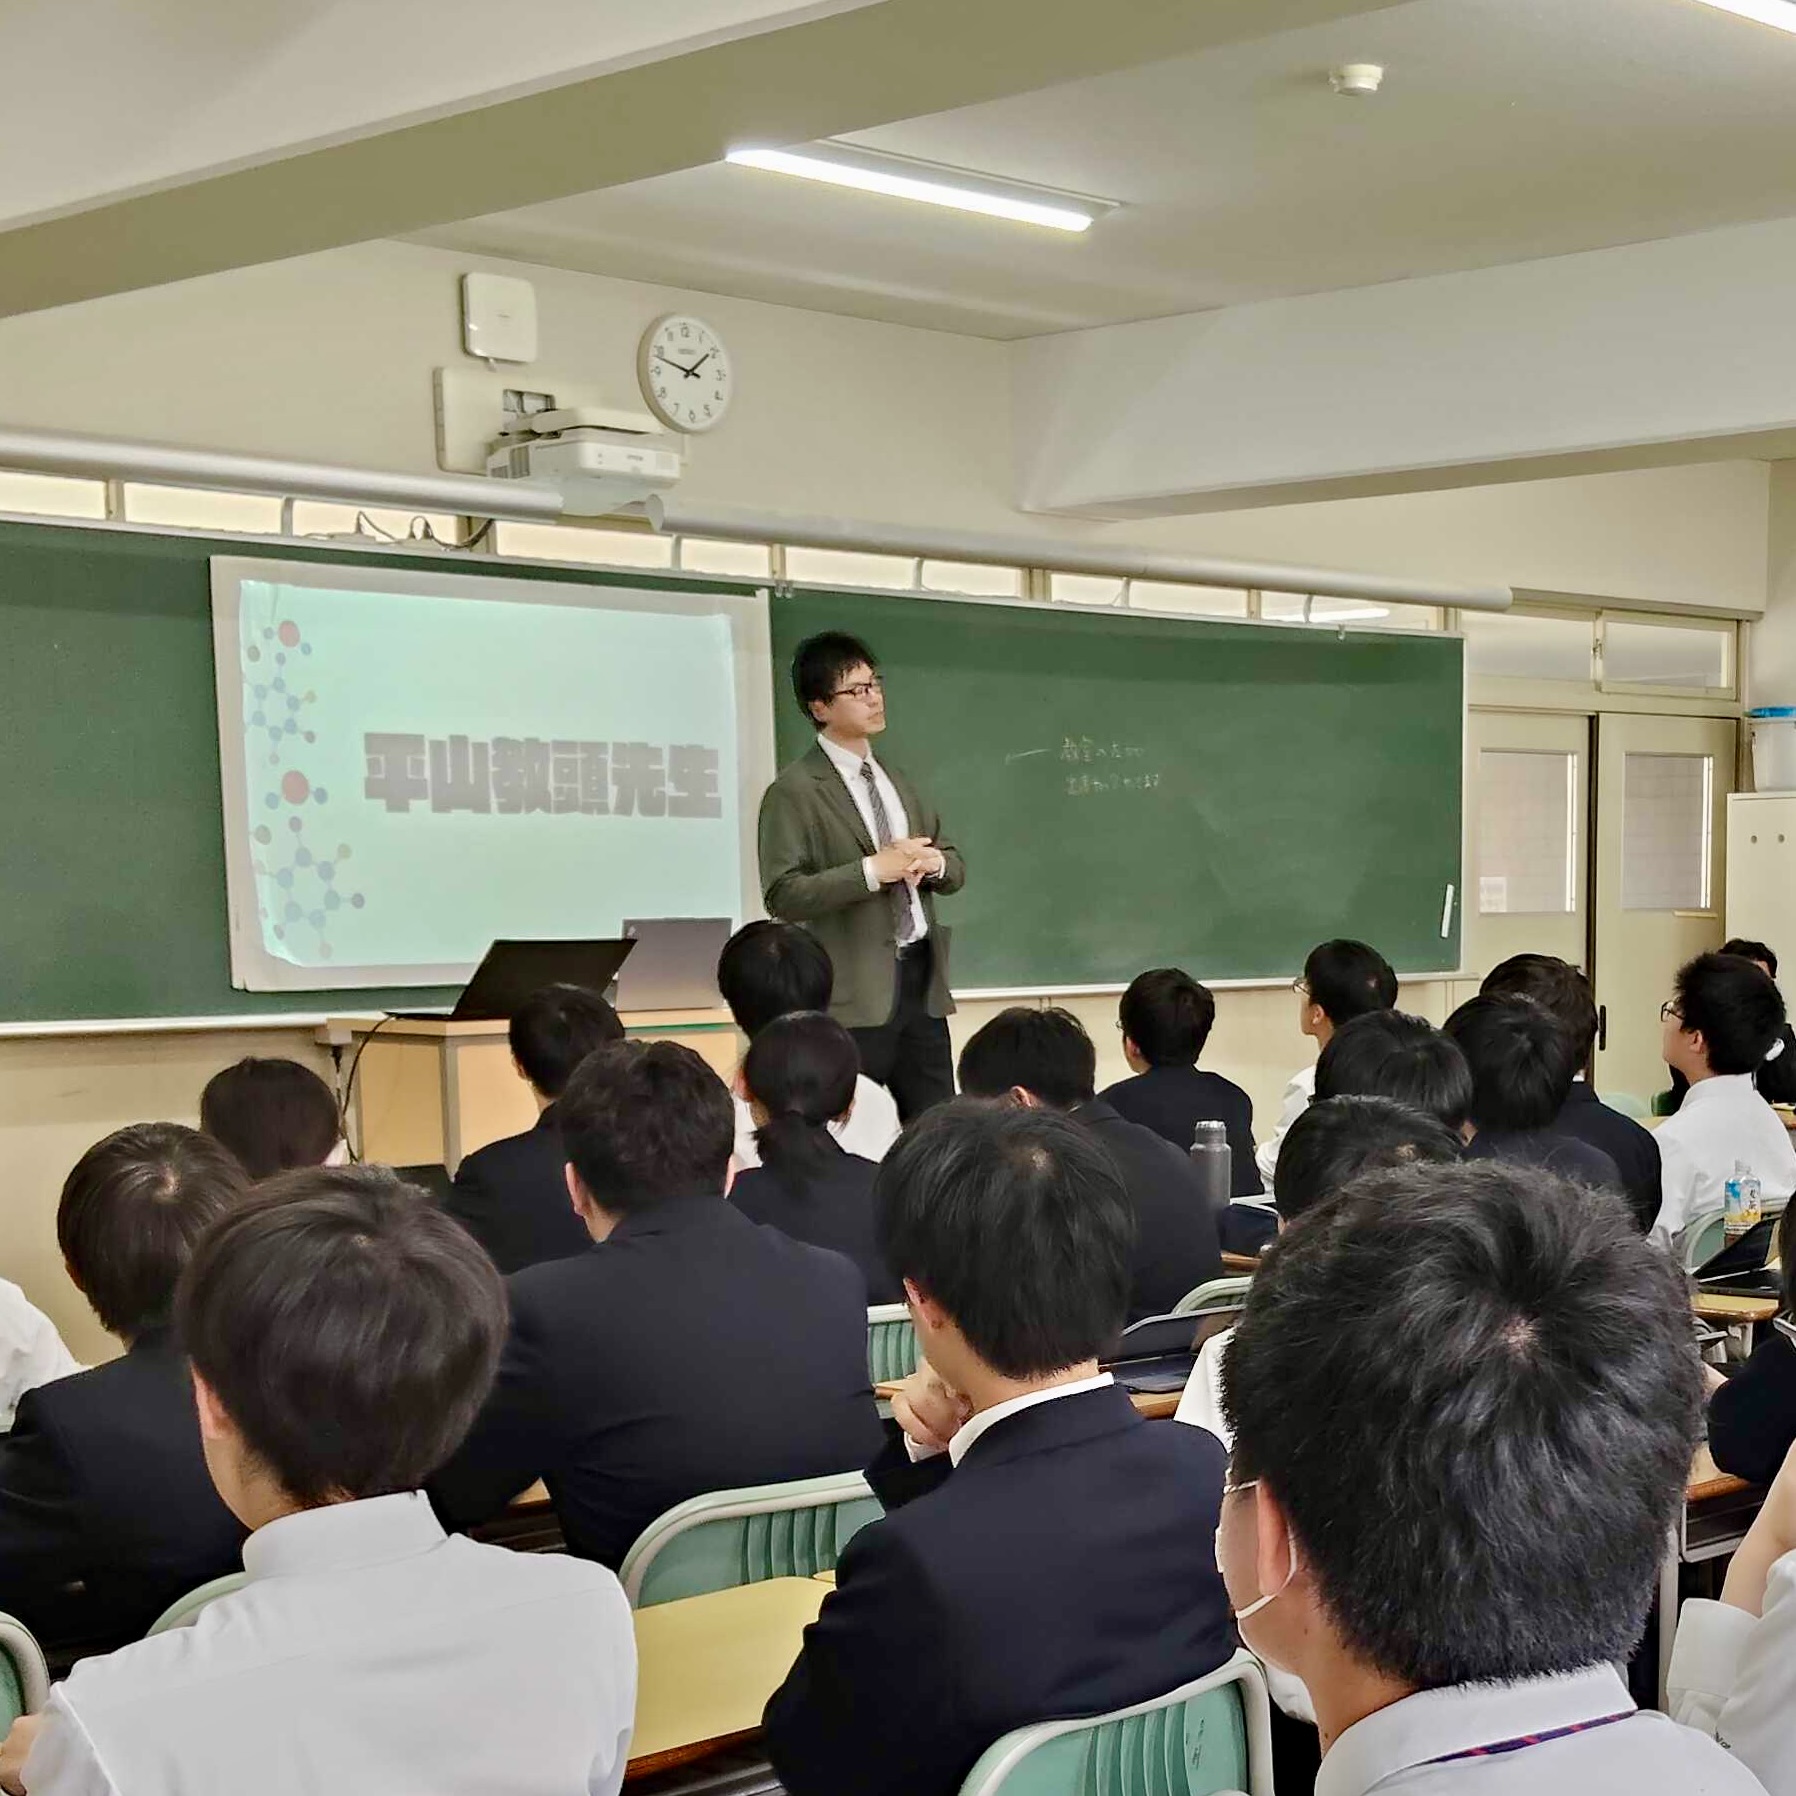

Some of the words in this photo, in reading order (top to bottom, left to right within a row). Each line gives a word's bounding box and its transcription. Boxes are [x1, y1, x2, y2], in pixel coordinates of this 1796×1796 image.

[364, 733, 723, 819] 平山教頭先生
